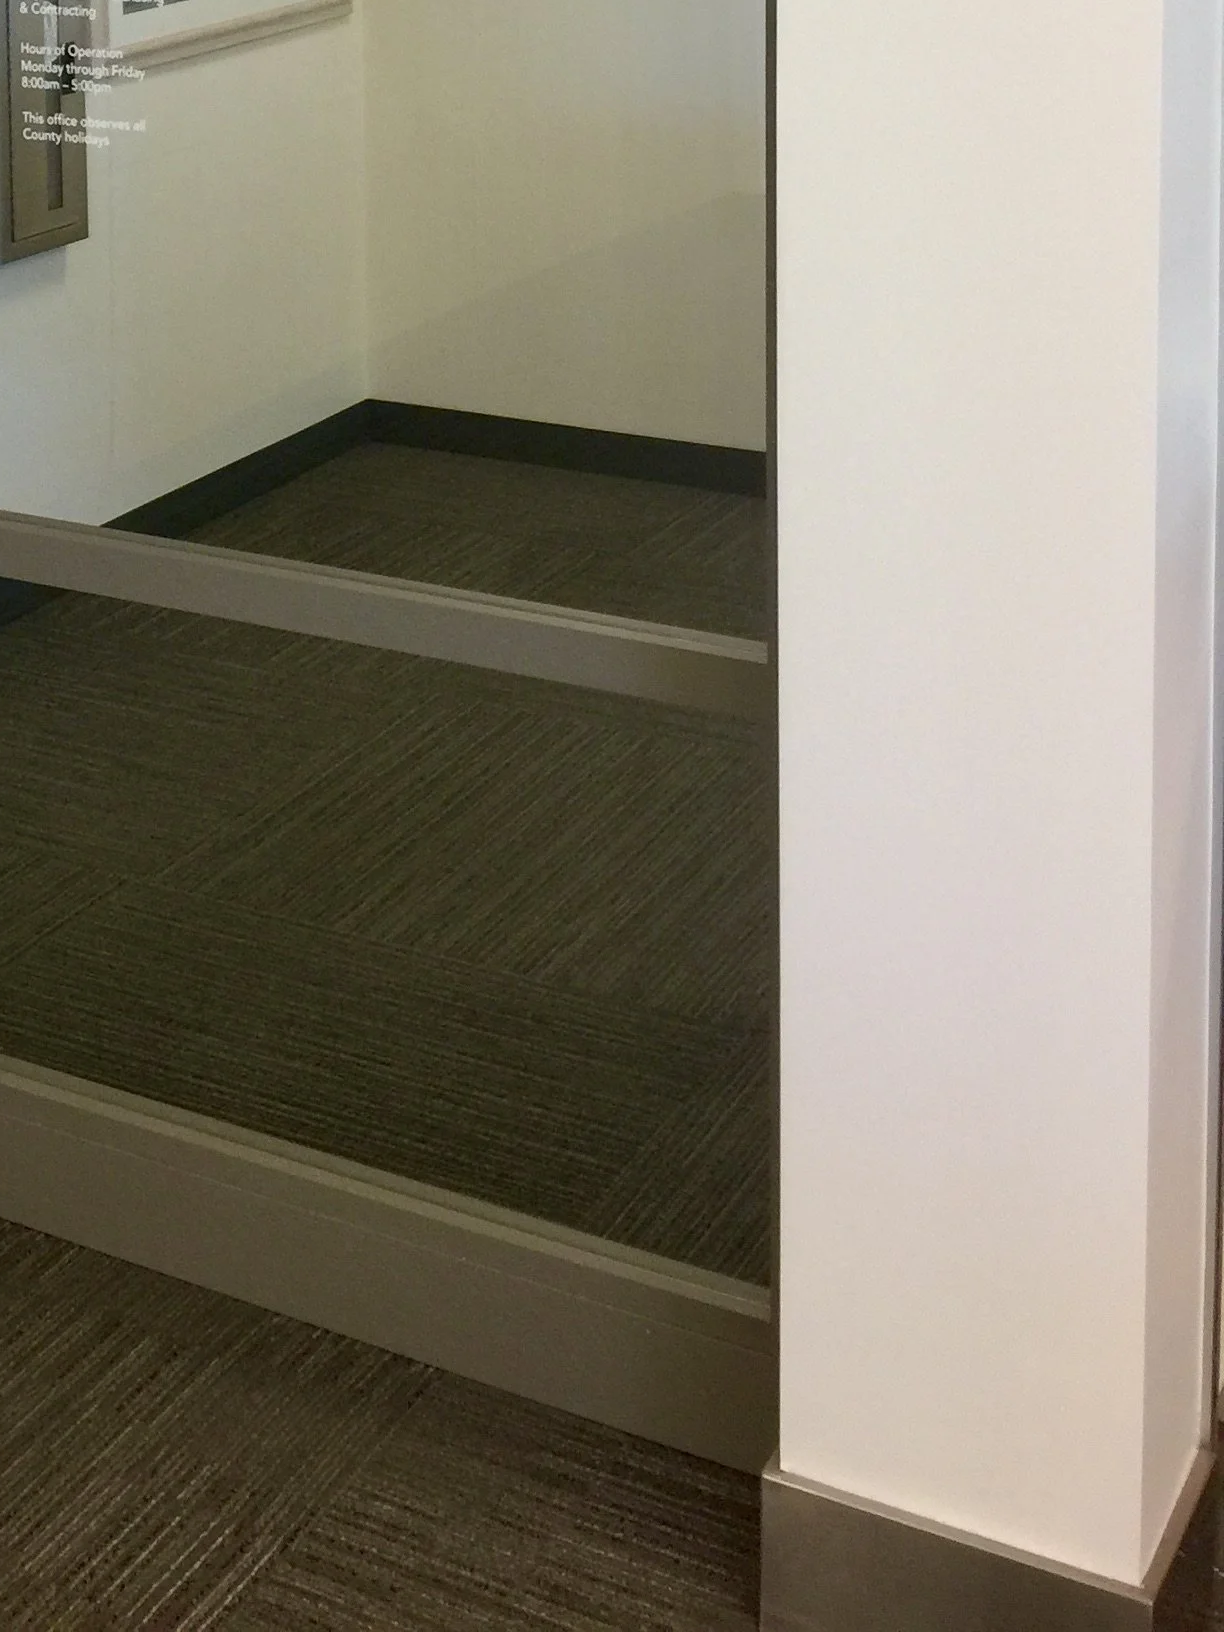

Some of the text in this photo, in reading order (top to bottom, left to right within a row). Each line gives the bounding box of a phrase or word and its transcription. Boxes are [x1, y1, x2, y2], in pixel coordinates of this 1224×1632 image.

[19, 2, 97, 20] & Contracting
[20, 42, 123, 60] Hours of Operation
[21, 60, 145, 81] Monday through Friday
[21, 76, 60, 90] 8:00am
[71, 78, 112, 96] 5:00pm
[22, 111, 146, 132] This office observes all
[22, 128, 110, 148] County holidays
